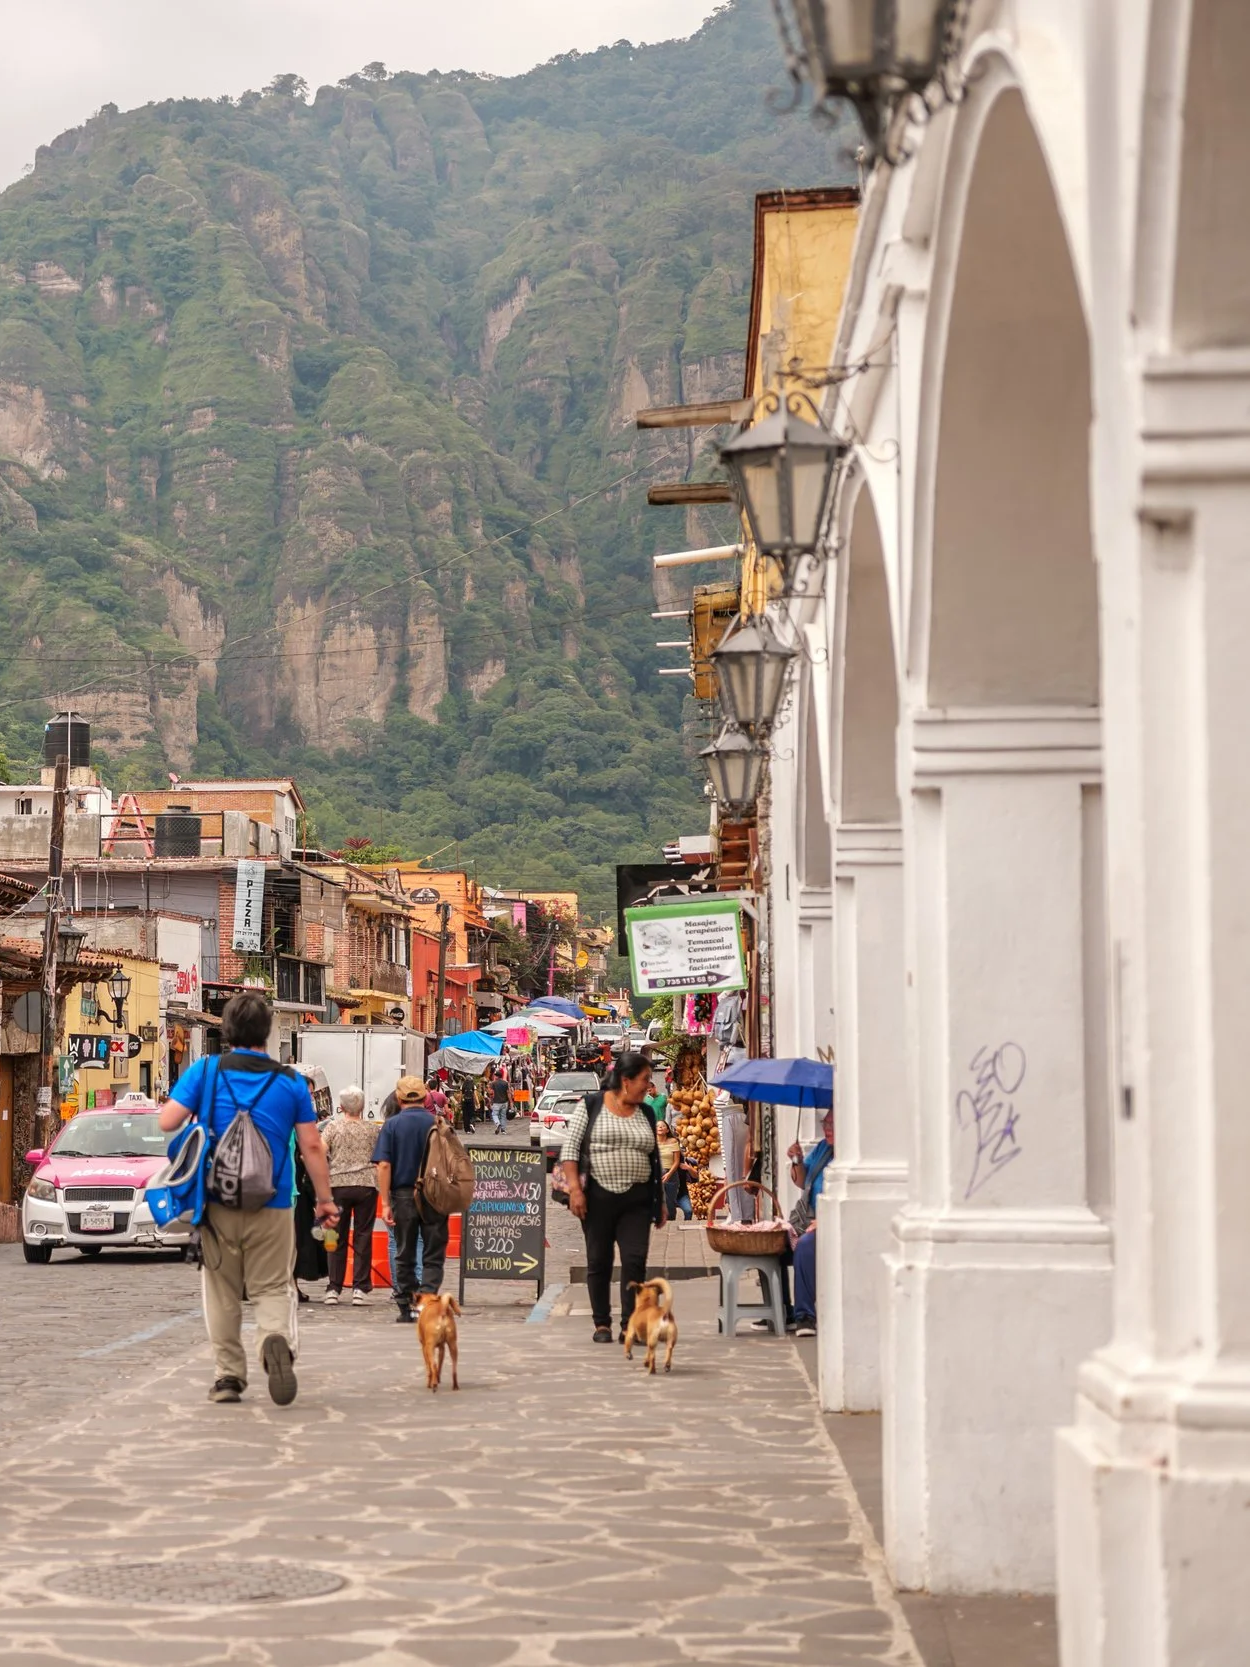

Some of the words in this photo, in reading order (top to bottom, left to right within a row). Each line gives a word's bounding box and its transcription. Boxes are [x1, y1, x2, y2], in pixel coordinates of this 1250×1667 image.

[244, 880, 254, 928] PIZZA
[684, 919, 718, 929] Masajes
[685, 926, 734, 935] terapéuticos
[687, 937, 724, 946] Temazcal
[687, 944, 733, 953] Ceremonial
[688, 954, 736, 964] Tratamientos
[689, 963, 720, 972] faciales
[469, 1215, 475, 1226] 2
[476, 1214, 542, 1229] HAMBURGUESAS
[470, 1228, 486, 1238] CON
[488, 1226, 522, 1239] PAPAS
